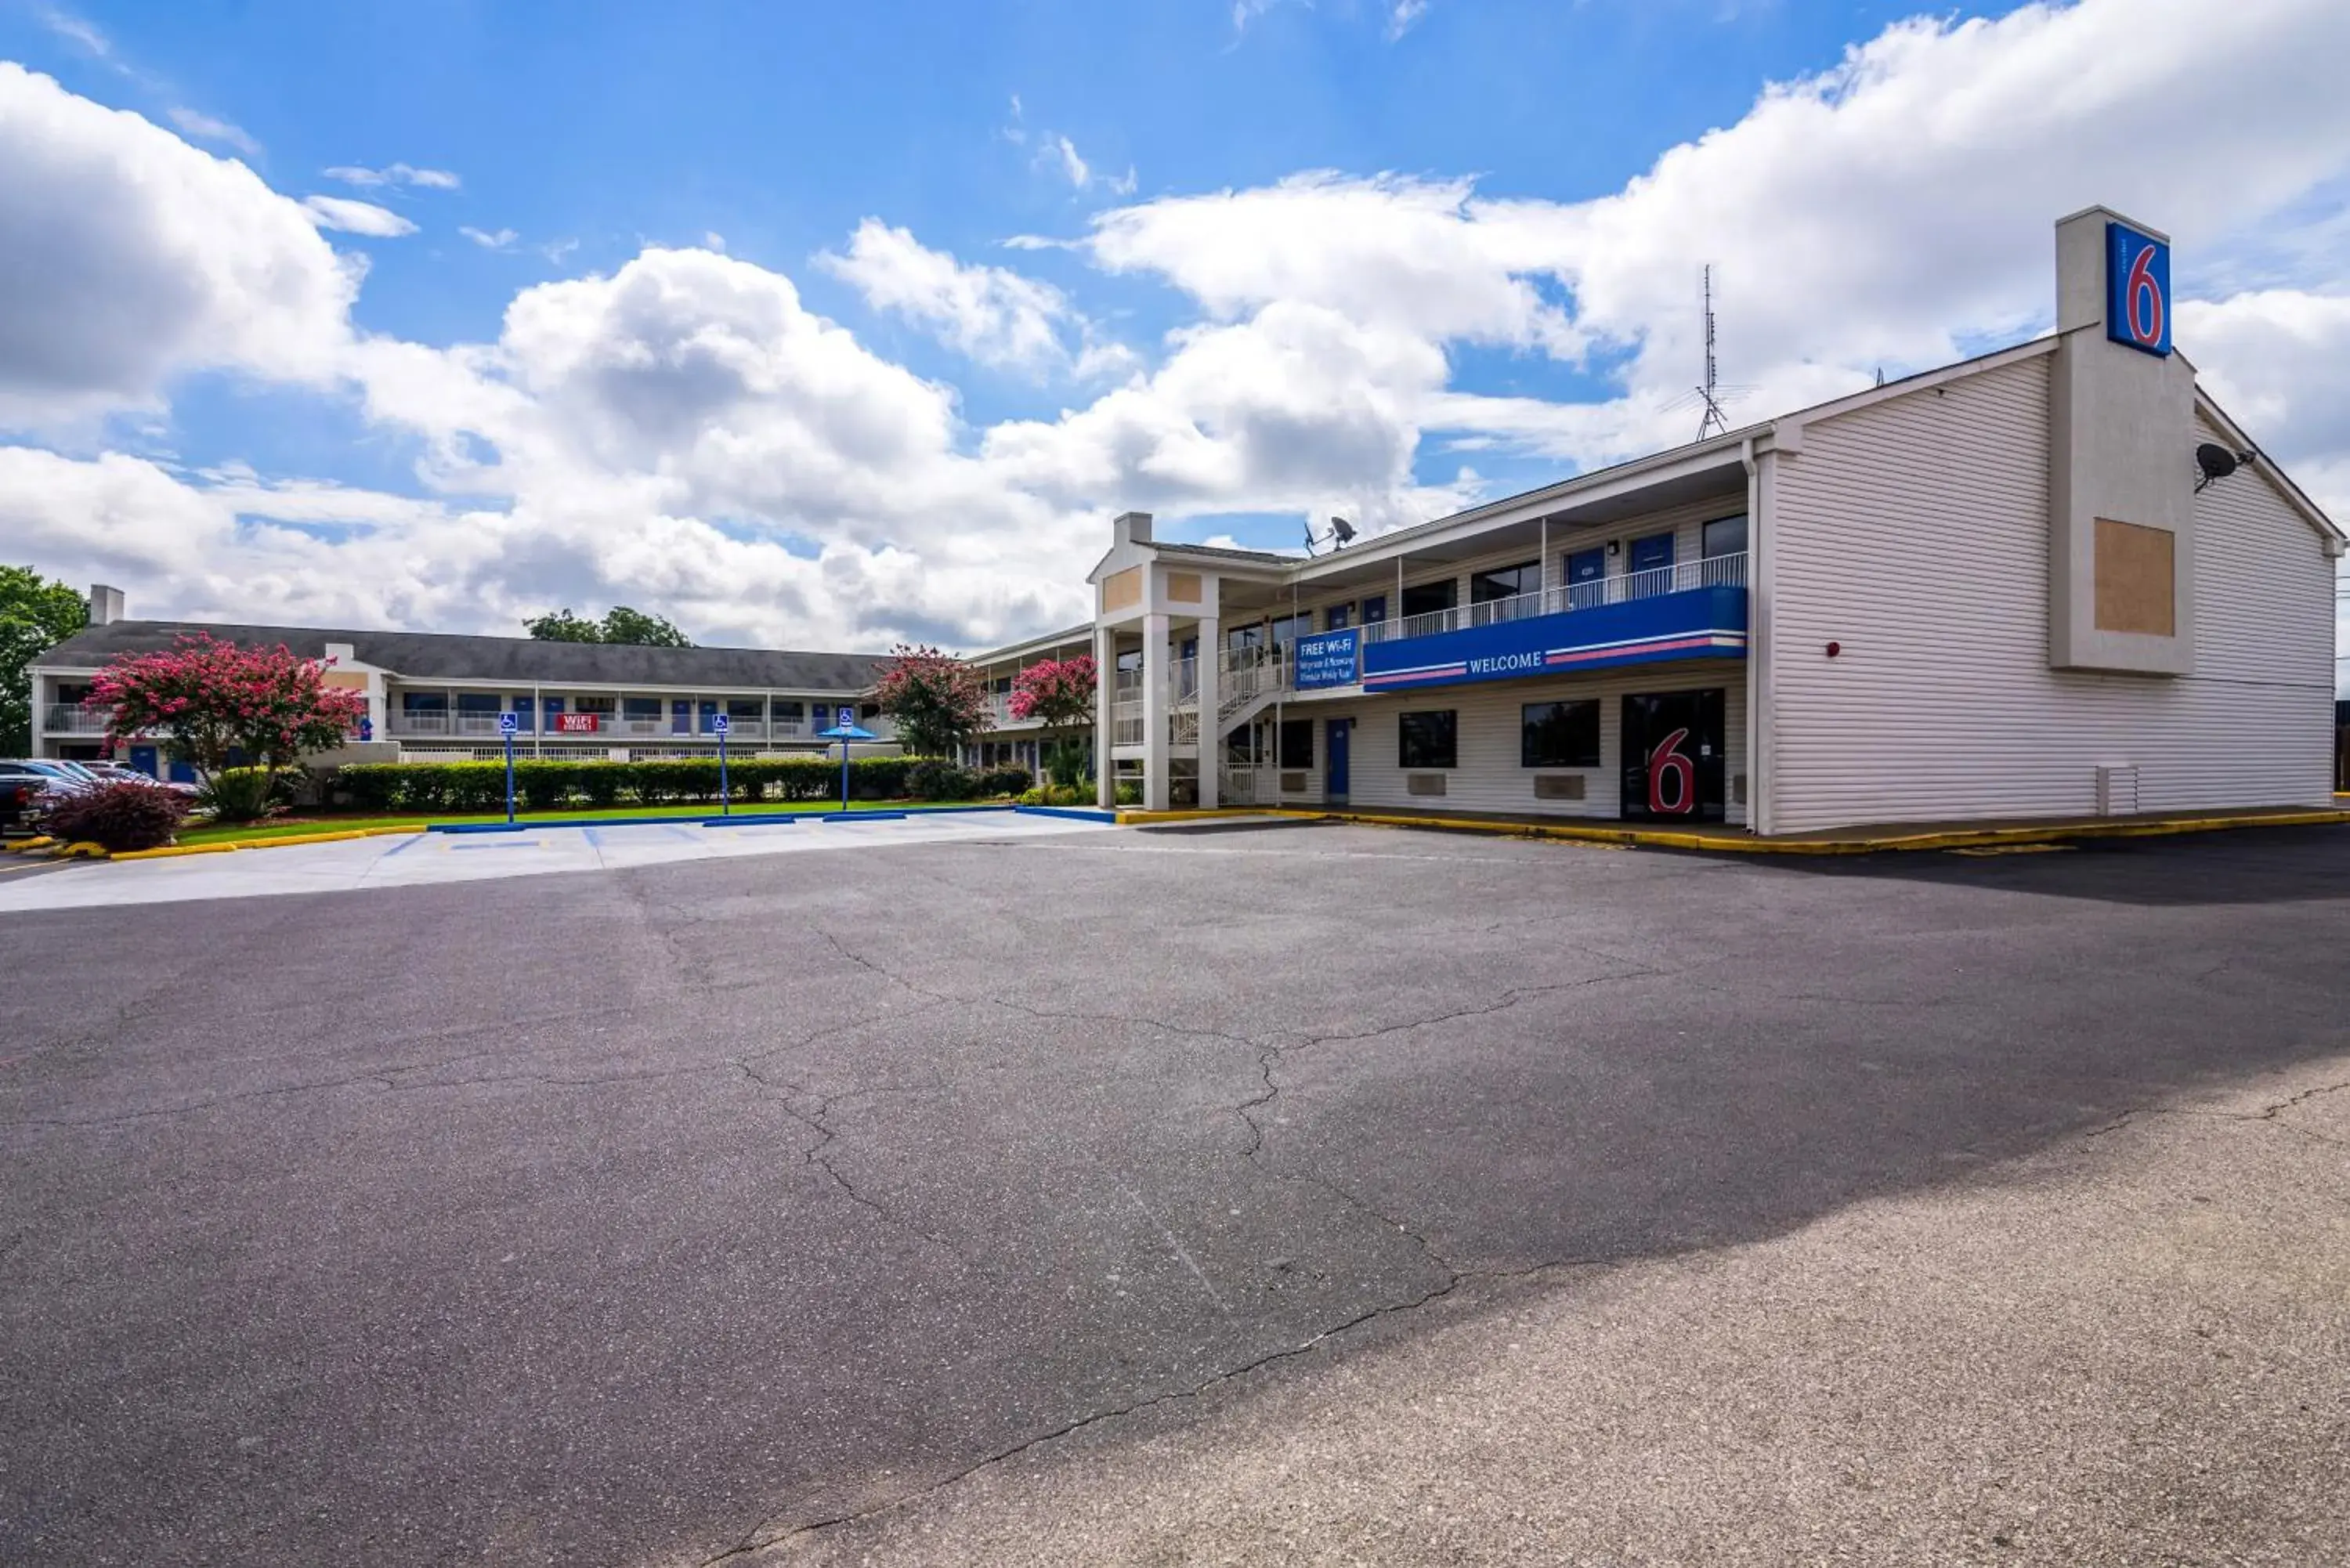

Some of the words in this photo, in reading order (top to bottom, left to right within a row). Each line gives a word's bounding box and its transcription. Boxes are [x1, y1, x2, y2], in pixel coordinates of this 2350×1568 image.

[2127, 244, 2164, 348] 6
[1301, 641, 1325, 656] FREE
[1470, 651, 1542, 674] WELCOME
[1650, 728, 1693, 813] 6
